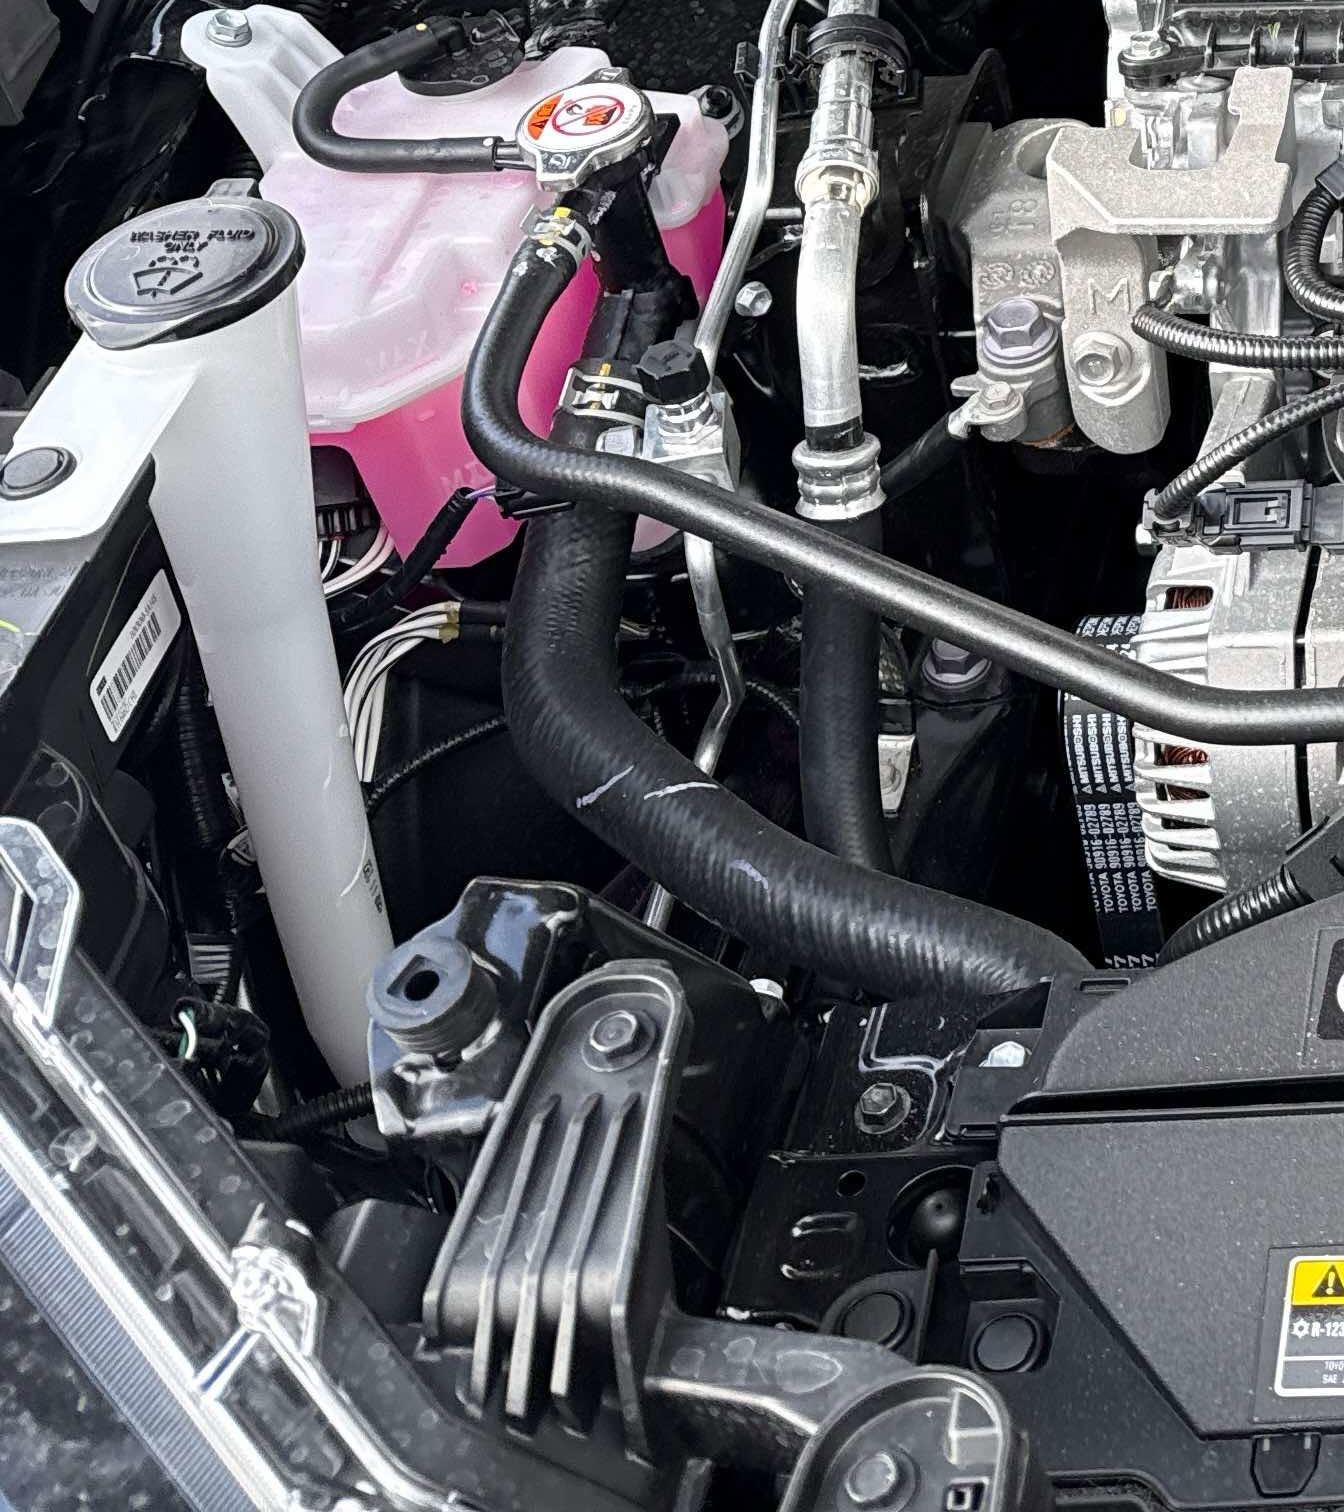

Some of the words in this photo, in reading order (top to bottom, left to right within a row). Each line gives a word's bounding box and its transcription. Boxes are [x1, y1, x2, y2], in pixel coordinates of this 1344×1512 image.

[1083, 803, 1107, 869] 90916-02789
[1098, 803, 1121, 869] 90916-02789
[1112, 802, 1135, 868] 90916-02789
[1098, 872, 1115, 913] TOYOTA
[1112, 872, 1128, 913] TOYOTA
[1127, 871, 1142, 912] TOYOTA
[1142, 870, 1158, 912] TOYOTA
[1322, 1374, 1338, 1384] SAE
